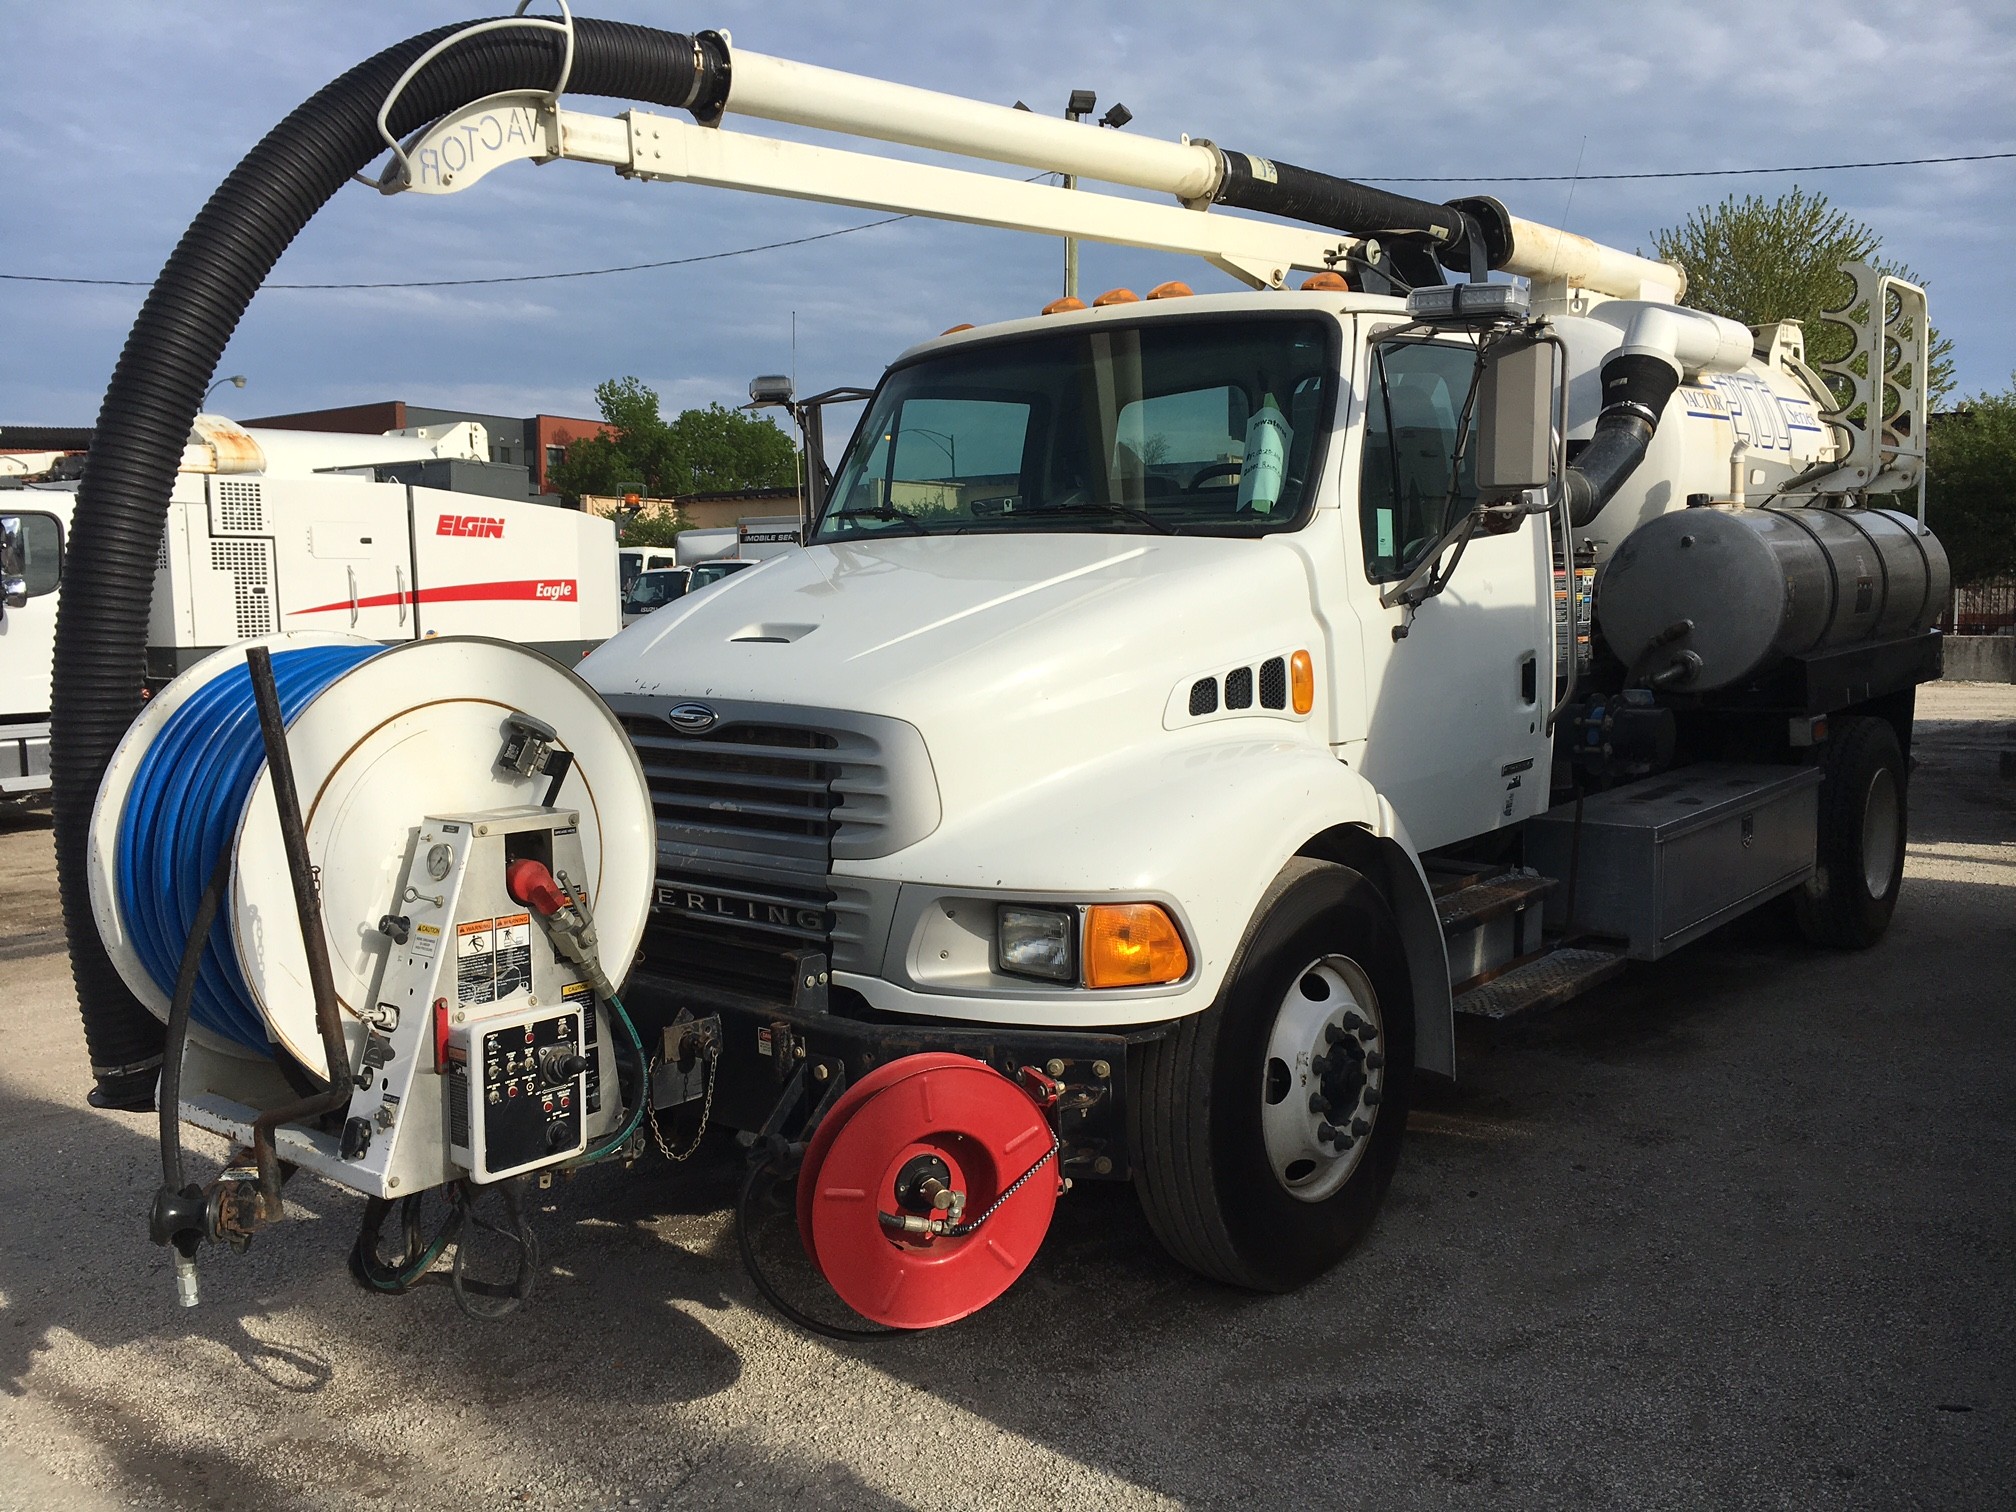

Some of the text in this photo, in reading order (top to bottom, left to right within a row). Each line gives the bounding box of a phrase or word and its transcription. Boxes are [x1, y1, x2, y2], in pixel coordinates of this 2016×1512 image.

[1679, 388, 1725, 411] VACTOR
[1785, 403, 1817, 426] Series
[436, 514, 505, 539] ELGIN
[745, 534, 776, 542] MOBILE
[536, 582, 572, 600] Eagle
